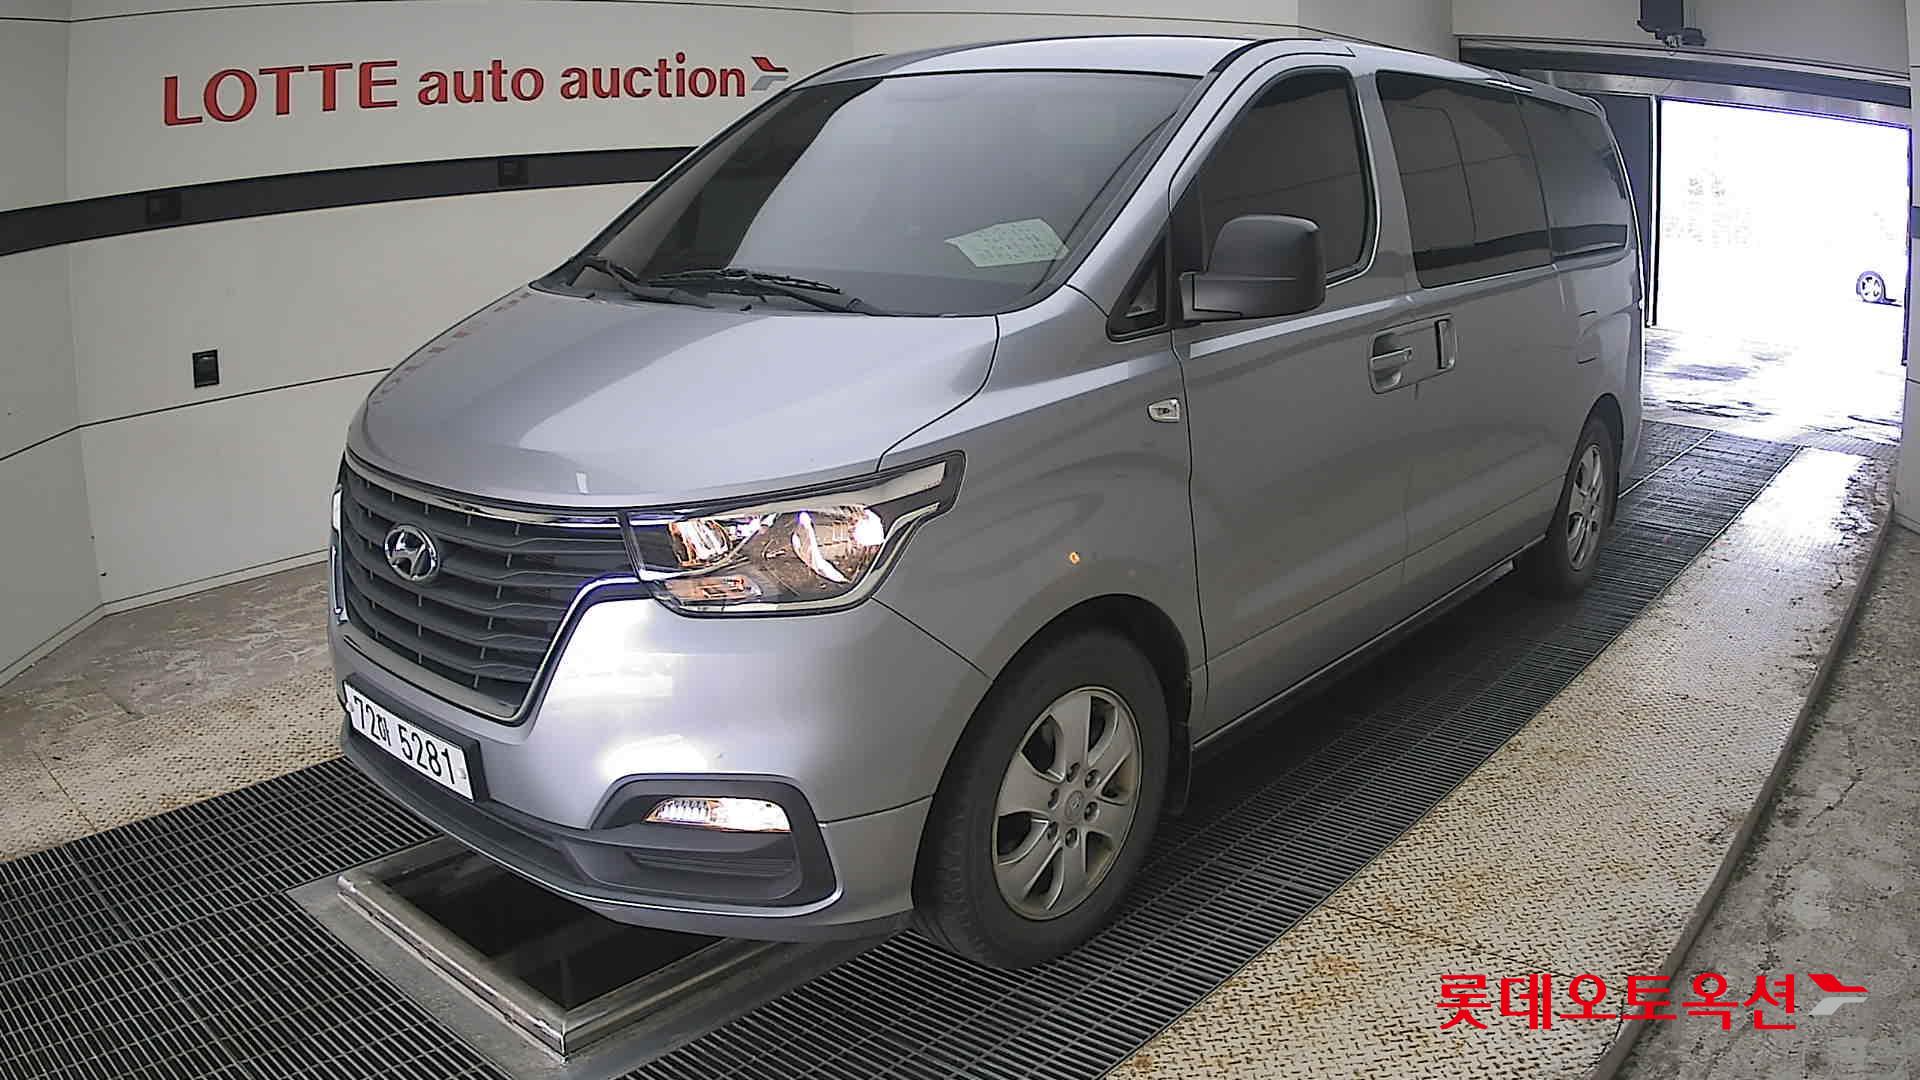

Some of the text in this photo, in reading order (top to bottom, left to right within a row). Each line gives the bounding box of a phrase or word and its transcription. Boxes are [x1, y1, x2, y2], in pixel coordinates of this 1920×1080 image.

[164, 52, 745, 126] LOTTE auto auction
[398, 723, 455, 785] 5281
